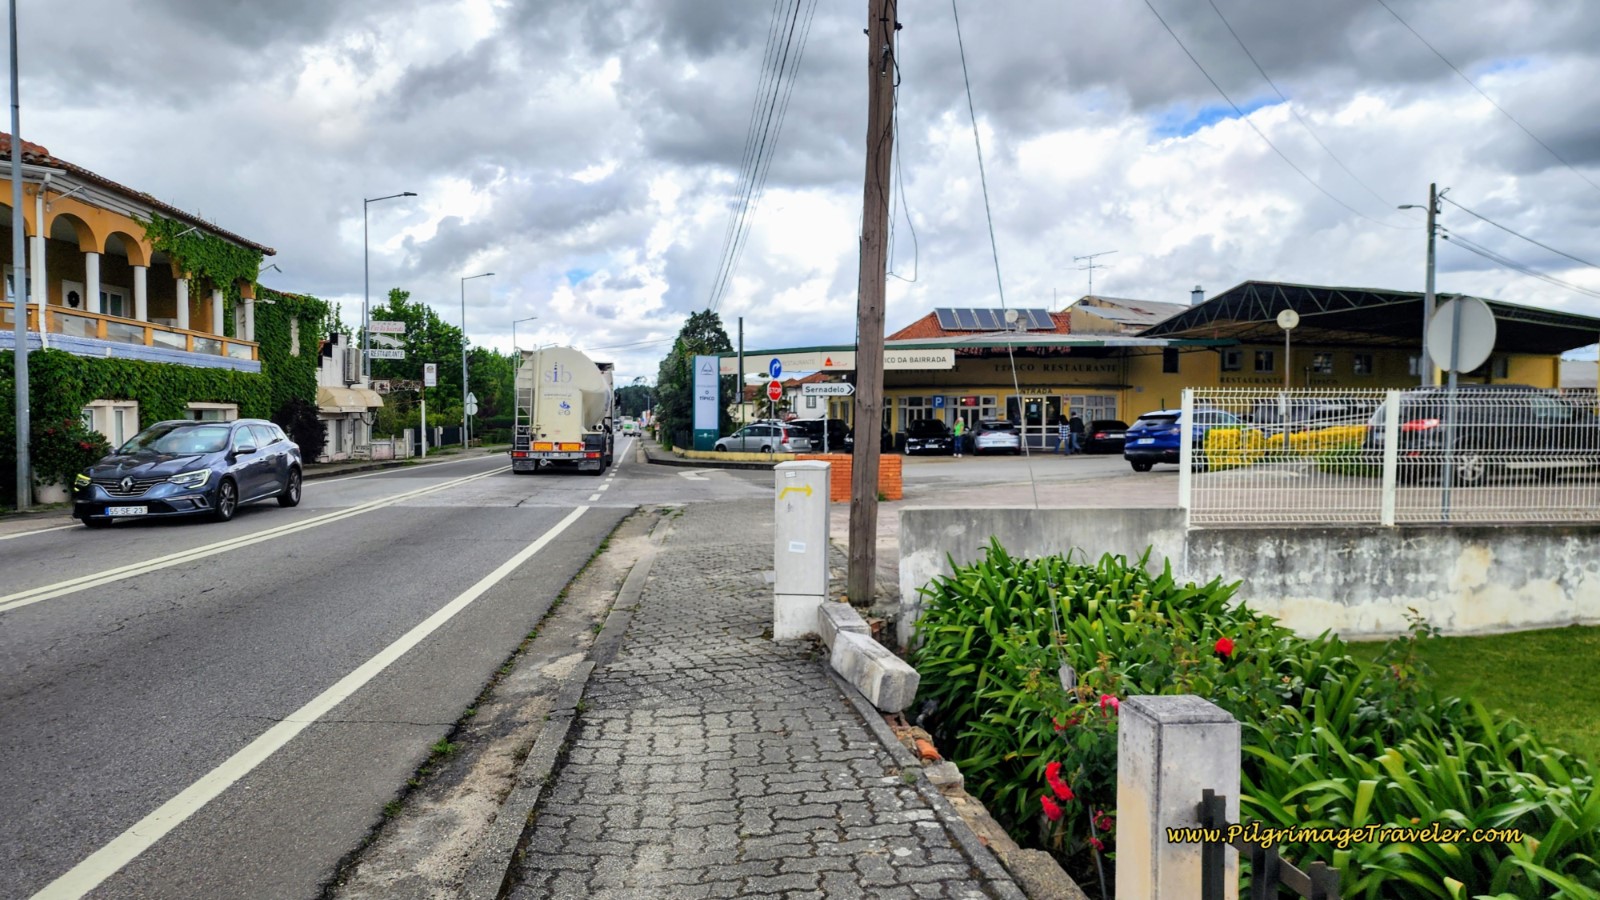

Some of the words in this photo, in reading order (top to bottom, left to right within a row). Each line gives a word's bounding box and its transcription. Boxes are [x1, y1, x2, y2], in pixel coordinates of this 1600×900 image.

[897, 356, 907, 364] DA
[544, 361, 572, 383] sib
[768, 386, 781, 394] STOP
[805, 385, 845, 393] Sernadelo
[935, 397, 942, 406] P
